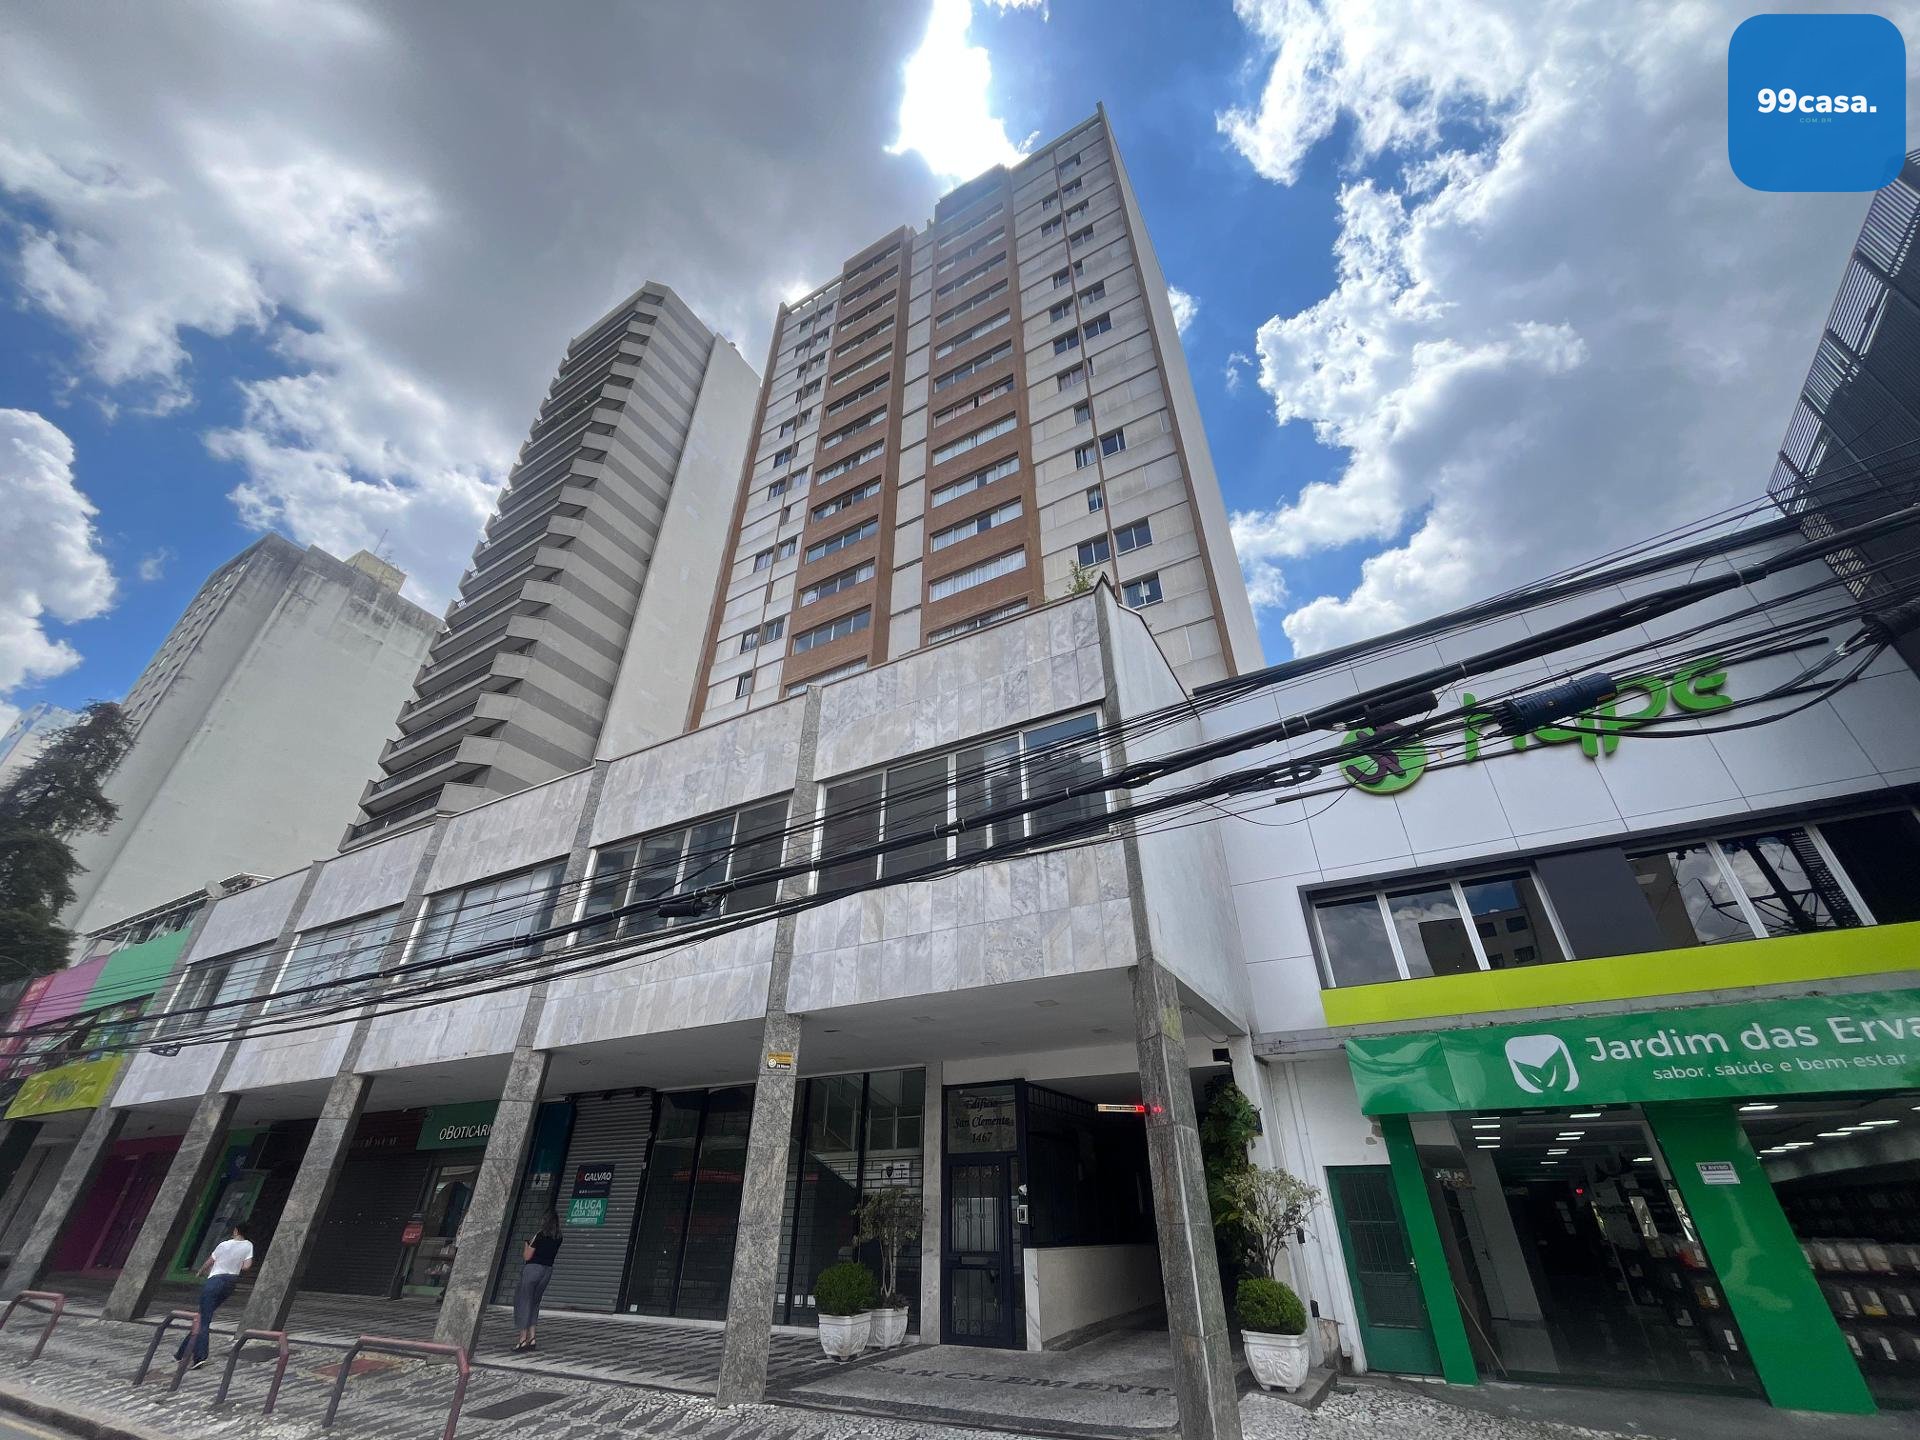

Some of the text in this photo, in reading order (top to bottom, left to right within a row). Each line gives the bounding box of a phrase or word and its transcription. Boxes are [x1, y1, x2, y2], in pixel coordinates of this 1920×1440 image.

[1585, 1028, 1729, 1062] Jardim
[1739, 1023, 1819, 1051] das
[1715, 1059, 1774, 1077] saúde
[1779, 1062, 1792, 1073] e
[1798, 1053, 1906, 1071] bem-estar
[972, 1131, 993, 1143] 1467
[574, 1200, 602, 1210] ALUGA
[943, 1372, 1178, 1397] CLEMENT
